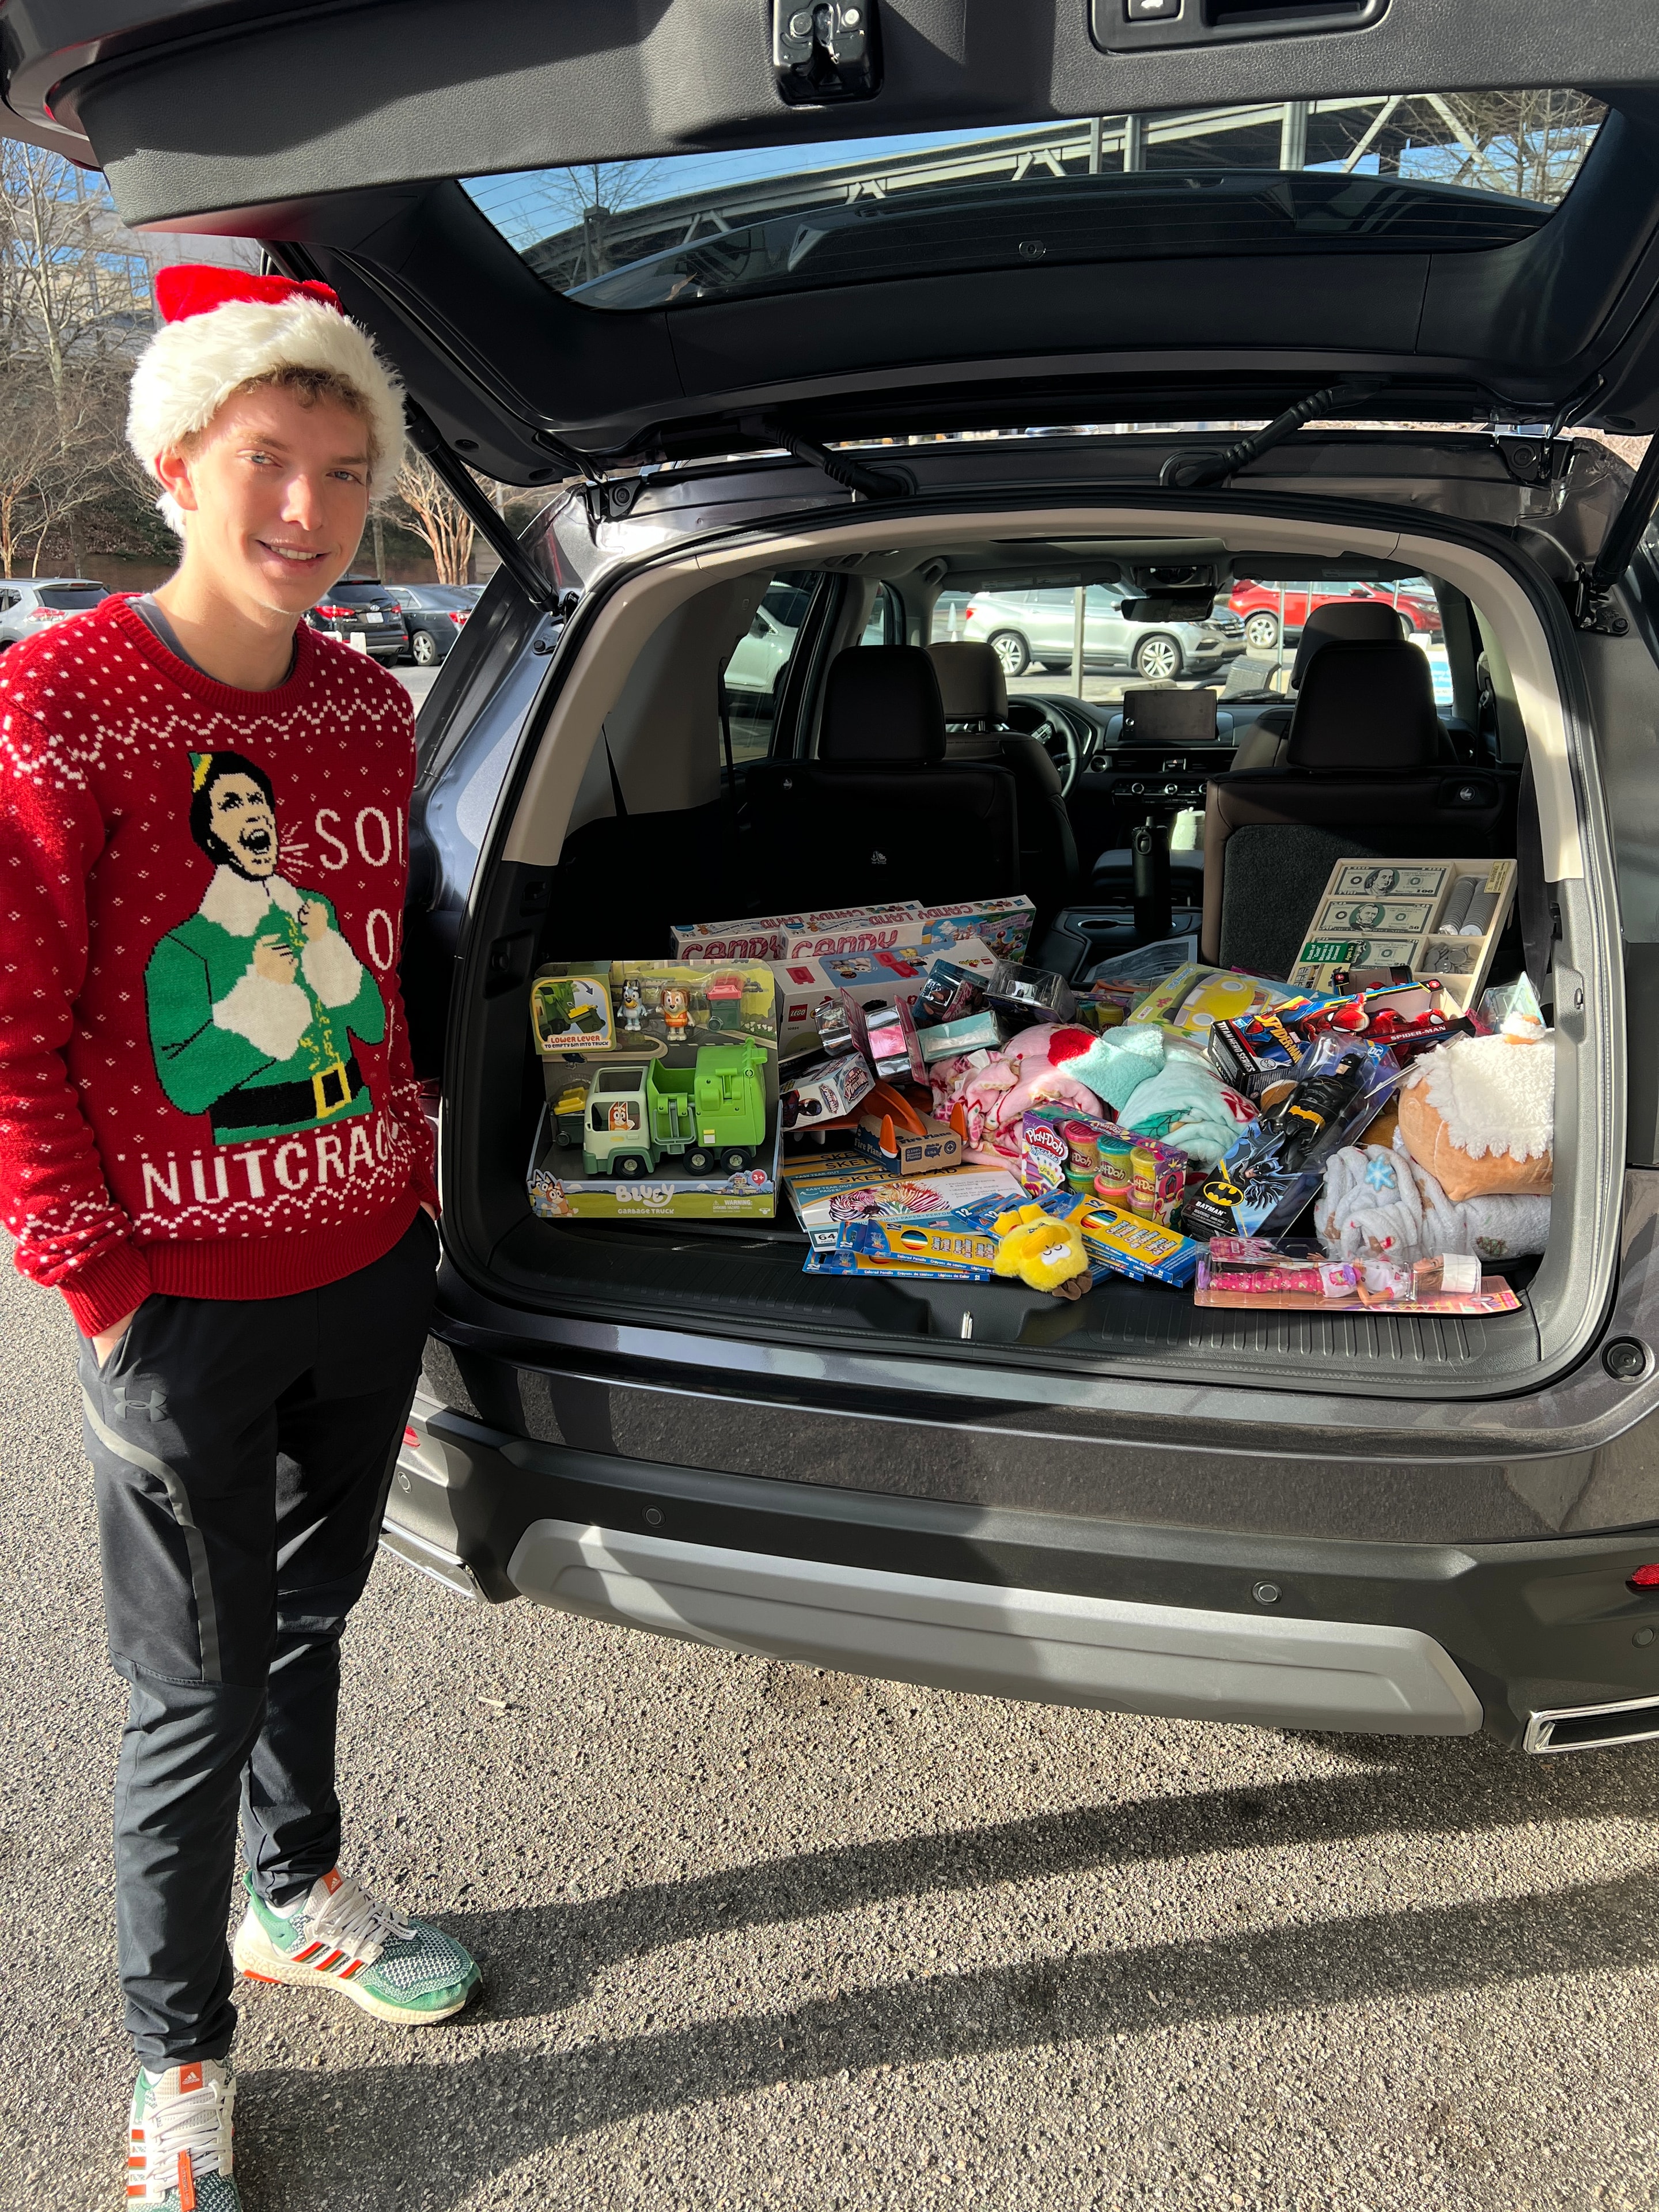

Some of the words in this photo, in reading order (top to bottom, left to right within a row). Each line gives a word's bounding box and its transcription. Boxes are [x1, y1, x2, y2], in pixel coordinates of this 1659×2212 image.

[316, 806, 402, 870] SO
[869, 911, 914, 926] LAND
[918, 904, 974, 920] CANDY
[681, 935, 780, 960] CANDY
[791, 929, 899, 959] CANDY
[1325, 945, 1335, 960] Wooden
[790, 1009, 806, 1017] LEGO
[550, 1036, 576, 1044] LOWER
[1253, 1015, 1304, 1064] SPIDER-MAN
[1390, 1025, 1446, 1041] SPIDER-MAN
[1216, 1021, 1232, 1038] TITAN
[1228, 1036, 1243, 1056] HERO
[1237, 1051, 1256, 1073] SERIES
[1368, 1046, 1383, 1056] DC
[924, 1131, 952, 1140] Plane
[1025, 1128, 1064, 1156] Play-Doh
[854, 1138, 866, 1150] Fire
[867, 1143, 882, 1159] Plane
[820, 1152, 853, 1160] SKE
[1072, 1152, 1093, 1166] -Doh
[141, 1118, 388, 1209] NUTCRAC
[825, 1158, 869, 1169] SKET
[1084, 1199, 1105, 1208] 12
[1195, 1200, 1224, 1216] BATMAN
[955, 1207, 973, 1218] 12
[983, 1210, 999, 1219] 12
[886, 1223, 903, 1231] 12
[1106, 1220, 1131, 1234] Colored
[1114, 1225, 1138, 1238] Pencils
[1123, 1229, 1149, 1243] Crayons
[1138, 1230, 1161, 1244] couleur
[1160, 1240, 1178, 1251] Color
[1091, 1240, 1105, 1248] Crayons
[1111, 1248, 1123, 1256] couleur
[1158, 1270, 1164, 1279] 12
[1095, 1250, 1109, 1259] Crayons
